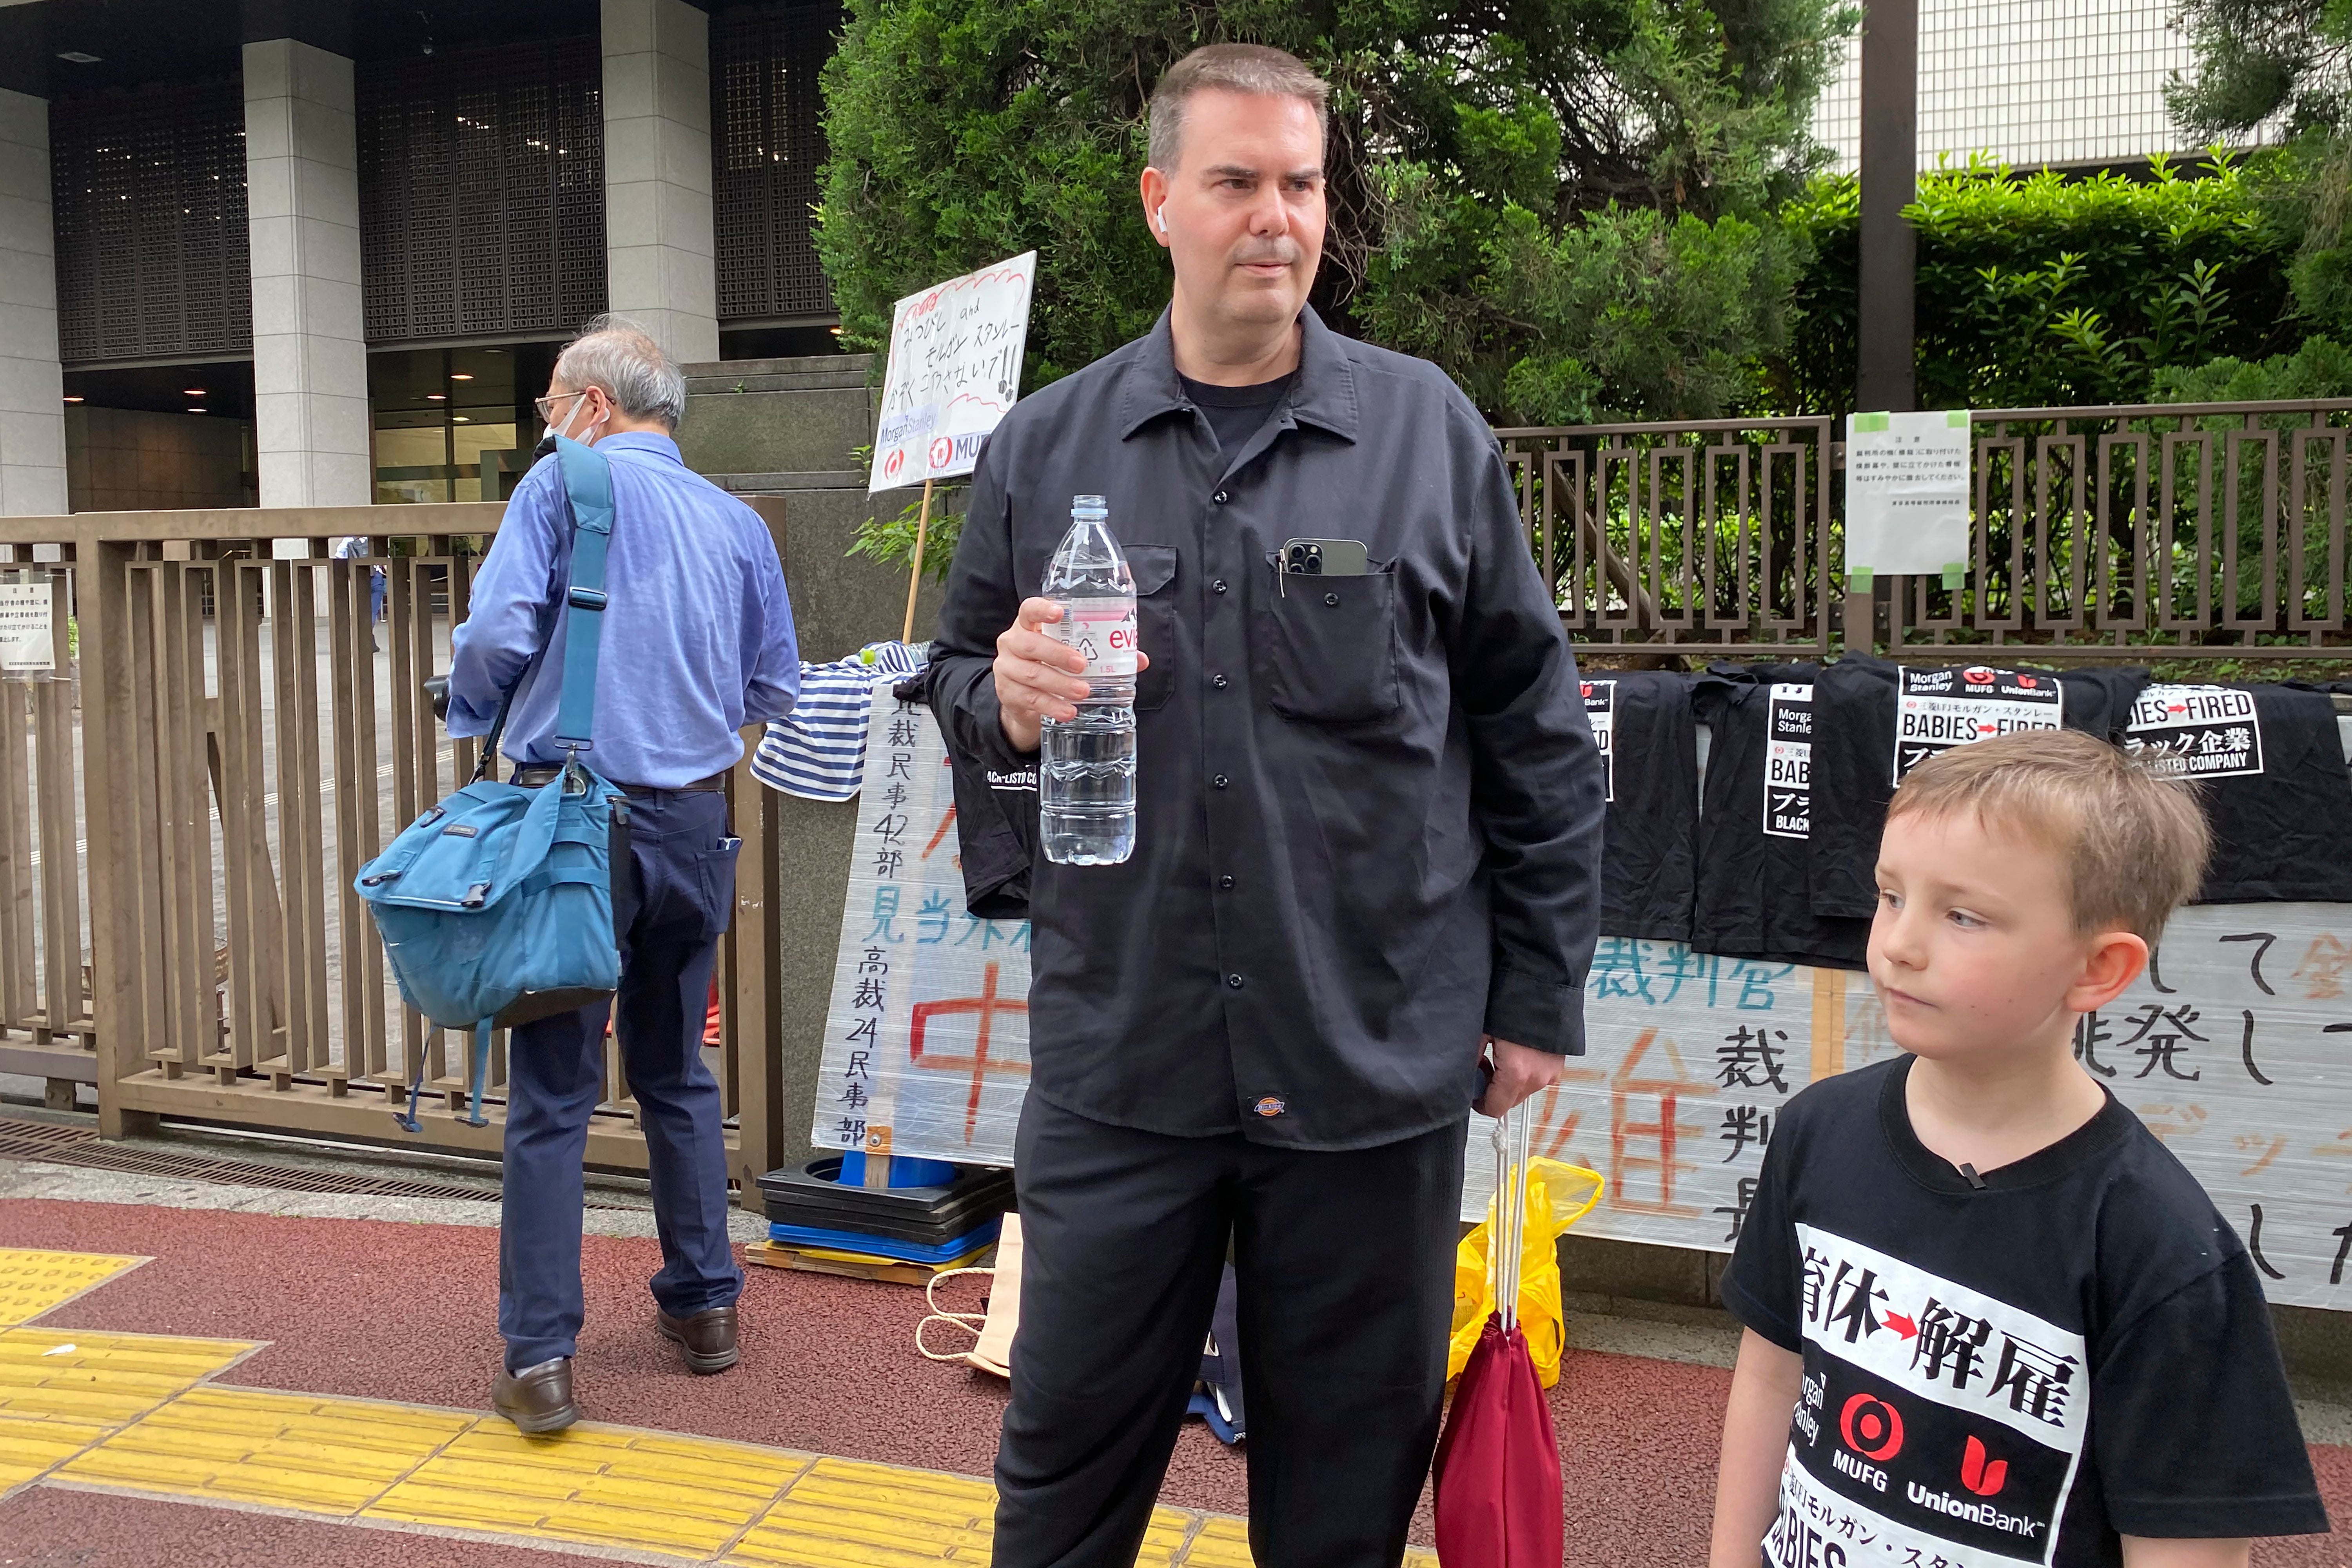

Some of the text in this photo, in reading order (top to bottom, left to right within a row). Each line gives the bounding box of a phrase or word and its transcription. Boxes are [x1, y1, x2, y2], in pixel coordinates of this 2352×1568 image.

[960, 297, 980, 321] and
[1909, 671, 1953, 692] Morgan Stanley
[1965, 684, 1994, 694] MUFG
[2001, 685, 2053, 698] UnionBank
[2185, 694, 2251, 720] FIRED
[1903, 713, 1978, 740] BABIES
[2124, 727, 2251, 758] ラック企業
[2189, 752, 2247, 771] COMPANY
[834, 946, 888, 1146] 高裁24民事部
[1909, 1296, 2081, 1428] 解雇
[1832, 1448, 1889, 1493] MUFG
[1907, 1480, 2036, 1538] UnionBank
